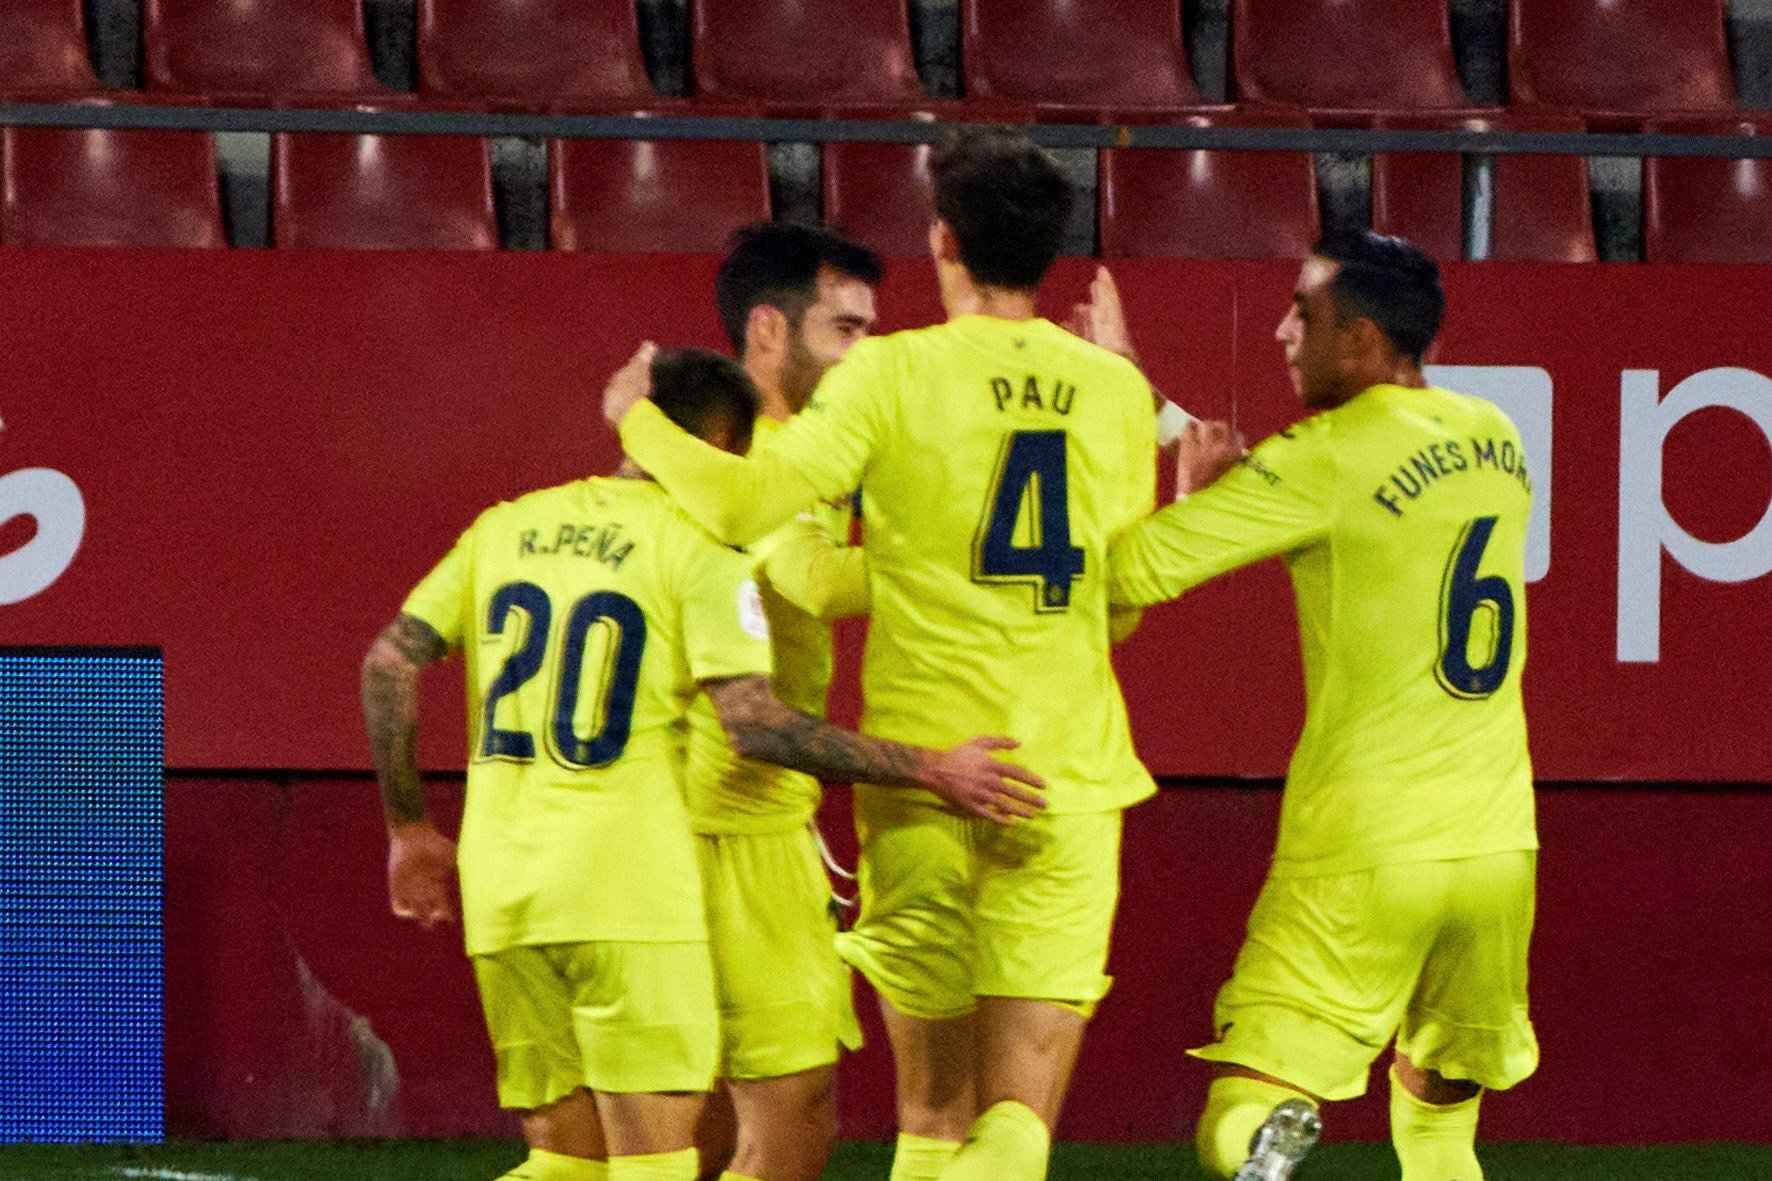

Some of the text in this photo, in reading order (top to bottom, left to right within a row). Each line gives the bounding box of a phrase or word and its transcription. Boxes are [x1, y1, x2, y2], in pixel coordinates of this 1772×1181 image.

[991, 375, 1076, 415] PAU
[1372, 440, 1469, 518] FUNES
[971, 428, 1086, 615] 4
[1434, 515, 1516, 701] 6
[479, 580, 647, 772] 20
